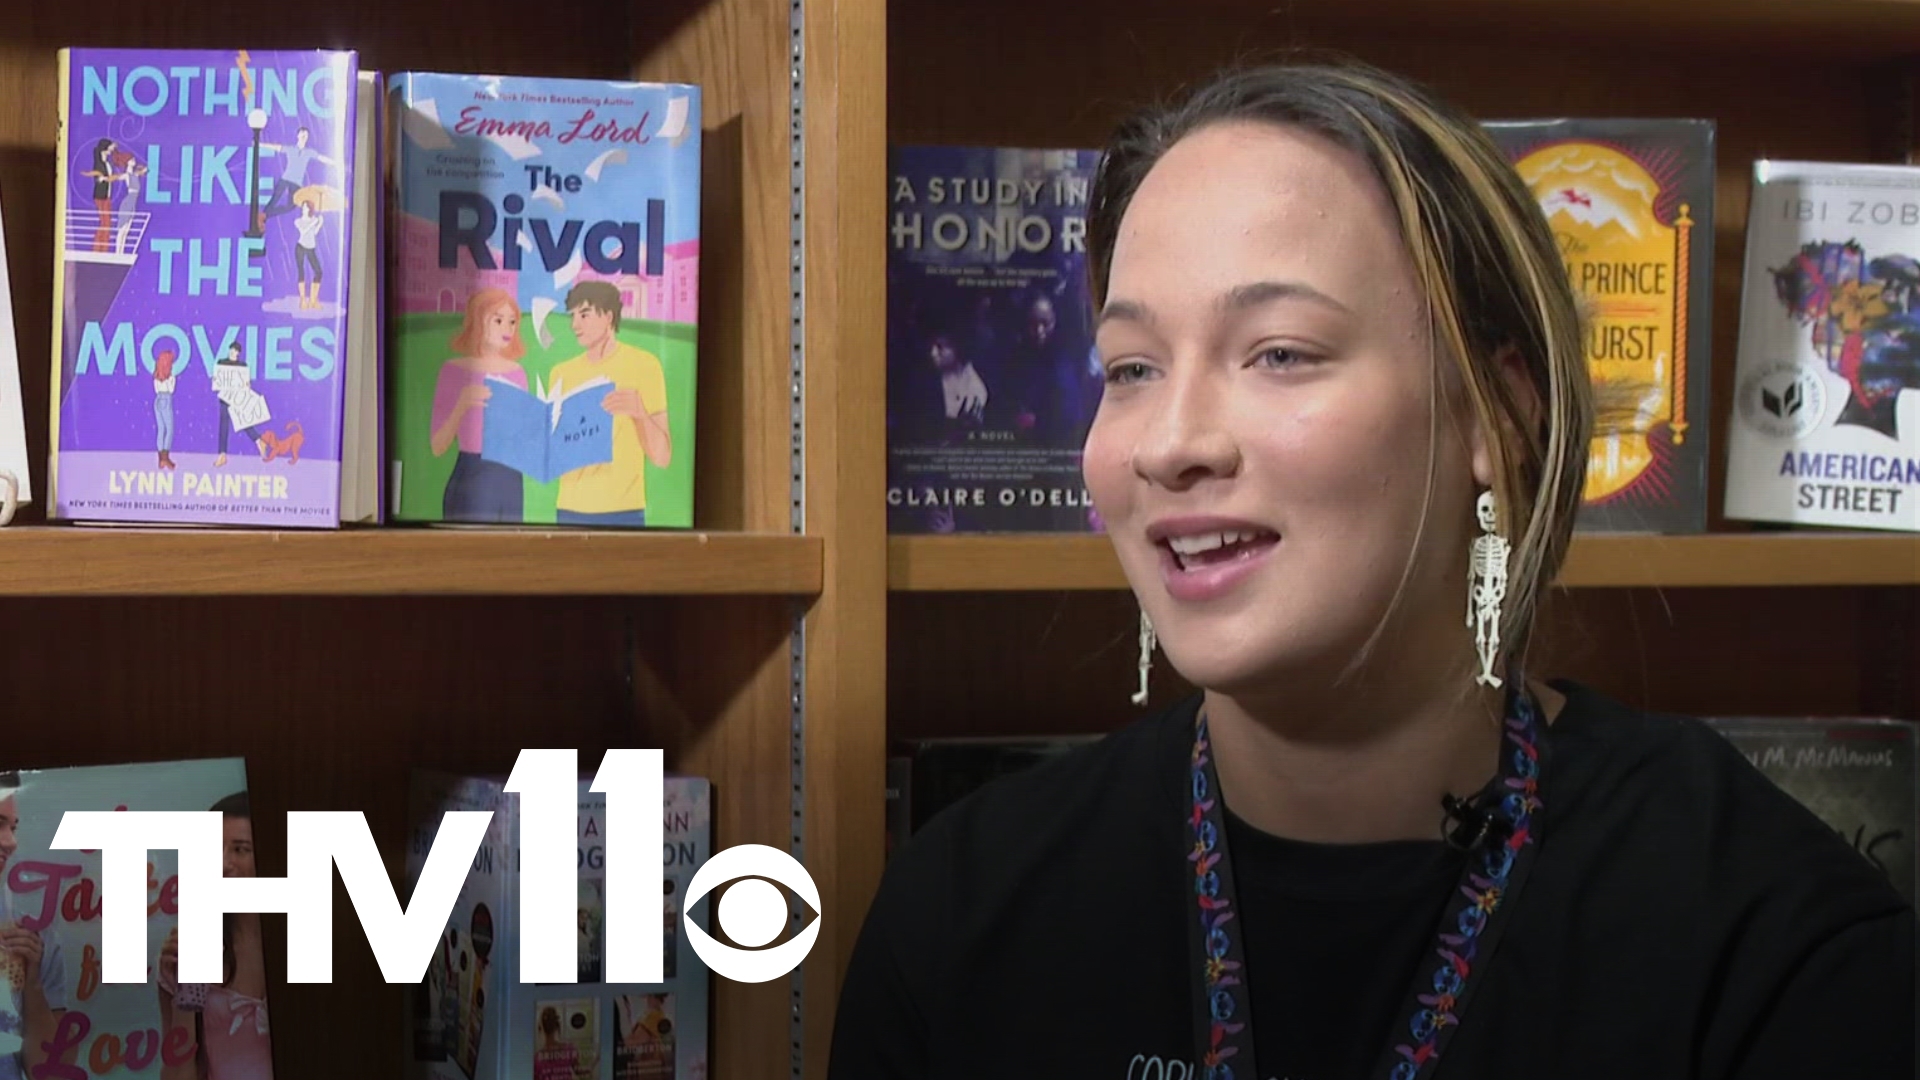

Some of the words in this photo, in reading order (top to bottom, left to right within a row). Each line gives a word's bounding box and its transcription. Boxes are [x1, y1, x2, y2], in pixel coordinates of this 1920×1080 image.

[82, 65, 337, 119] NOTHING
[520, 93, 547, 103] Times
[550, 95, 601, 107] Bestselling
[603, 96, 634, 107] Author
[454, 106, 553, 145] Emma
[558, 108, 649, 144] Lord
[145, 144, 276, 205] LIKE
[524, 164, 582, 193] The
[895, 177, 916, 201] A
[928, 177, 1044, 205] STUDY
[1055, 176, 1088, 206] IN
[1783, 199, 1827, 222] IBI
[1847, 201, 1919, 226] ZOB
[439, 190, 665, 276] Rival
[891, 212, 1086, 253] HONOR
[150, 237, 265, 297] THE
[1582, 262, 1666, 294] PRINCE
[75, 321, 335, 381] MOVIES
[1591, 325, 1659, 361] URST
[564, 424, 600, 443] NOVEL
[579, 415, 587, 425] A
[968, 431, 976, 440] A
[981, 431, 1015, 441] NOVEL
[1780, 450, 1920, 484] AMERICAN
[109, 470, 174, 495] LYNN
[183, 472, 288, 499] PAINTER
[887, 488, 986, 506] CLAIRE
[999, 488, 1093, 507] O'DELL
[1798, 483, 1902, 515] STREET
[69, 500, 85, 508] NEW
[88, 500, 107, 509] YORK
[110, 501, 132, 509] TIMES
[134, 501, 183, 510] BESTSELLING
[185, 503, 216, 512] AUTHOR
[218, 504, 228, 512] OF
[231, 504, 259, 513] BETTER
[261, 505, 281, 514] THAN
[284, 506, 298, 515] THE
[300, 507, 330, 516] MOVIES
[7, 860, 178, 931] Tate
[32, 1011, 198, 1080] Love
